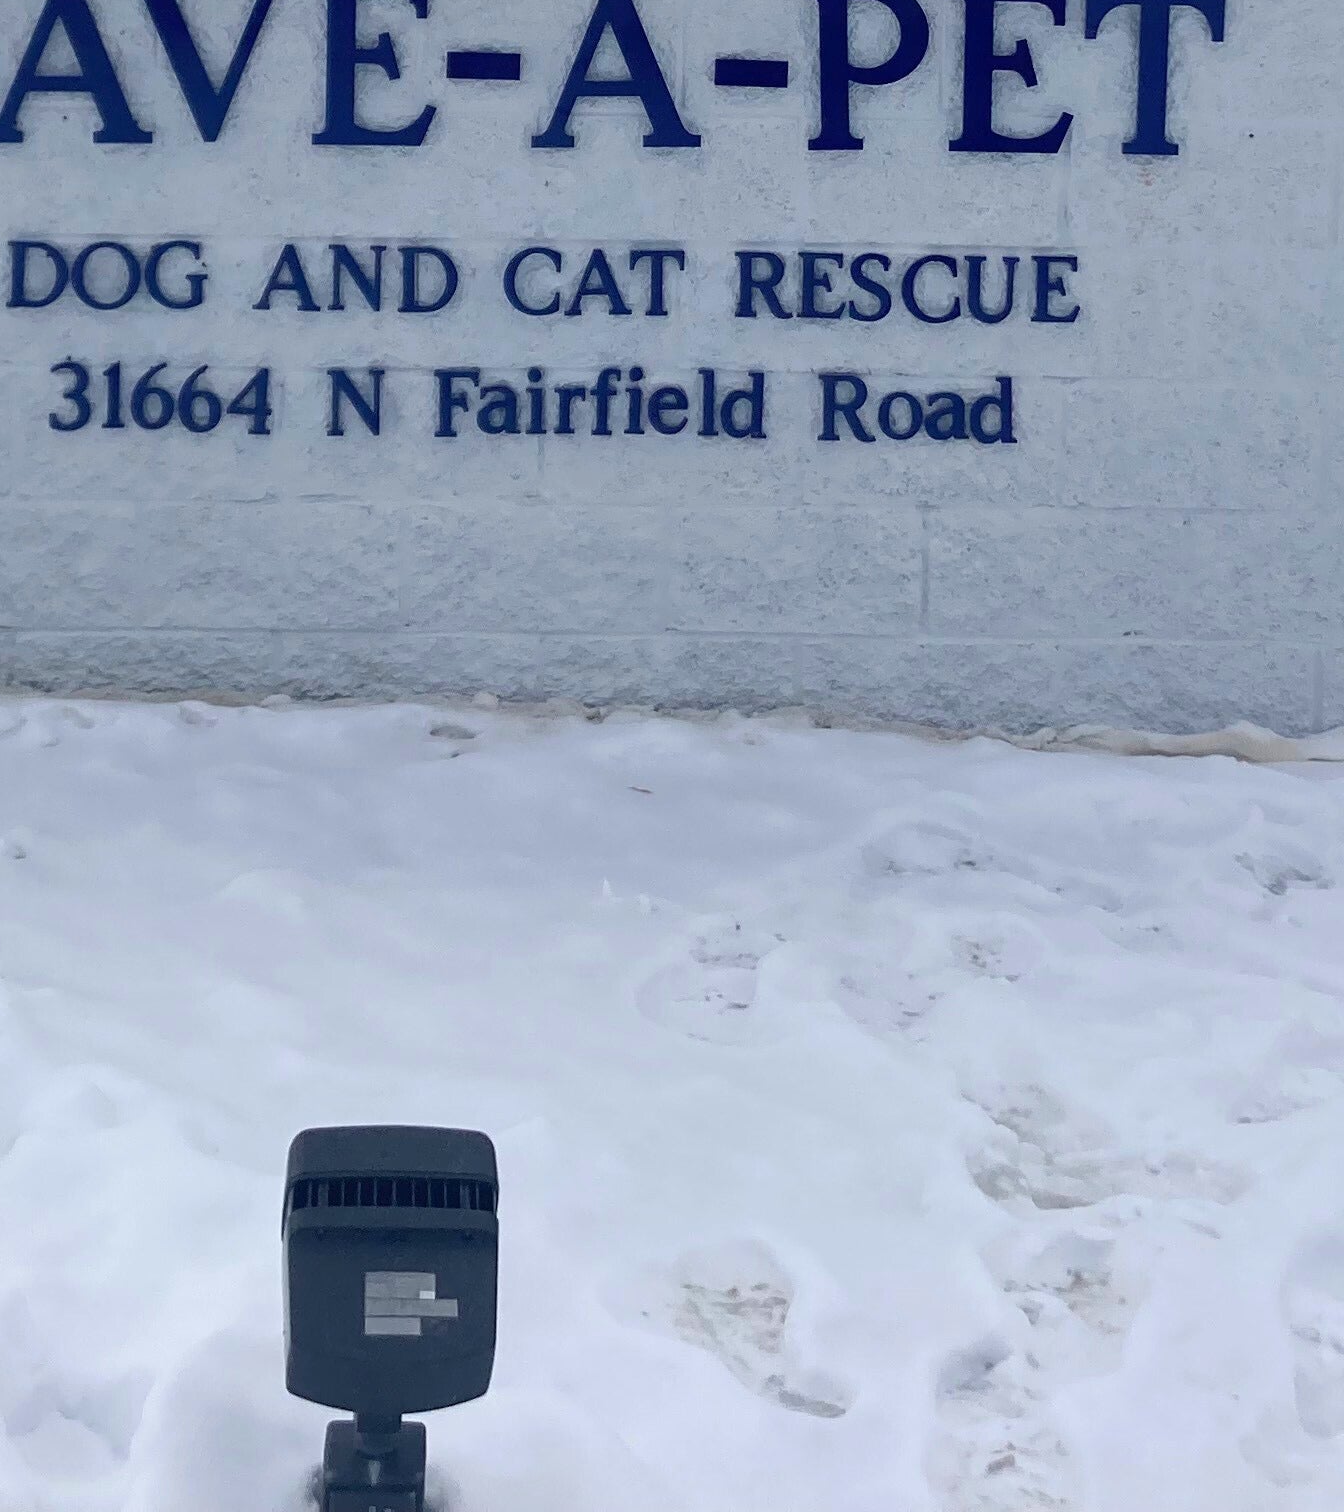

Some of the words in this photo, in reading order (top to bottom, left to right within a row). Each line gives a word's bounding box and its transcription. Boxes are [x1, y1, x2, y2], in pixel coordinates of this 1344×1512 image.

[8, 238, 208, 309] DOG
[256, 241, 460, 312] AND
[505, 245, 684, 318] CAT
[736, 251, 1079, 325] RESCUE
[48, 362, 272, 435] 31664
[327, 366, 388, 436] N
[433, 367, 766, 440] Fairfield
[817, 372, 1016, 443] Road
